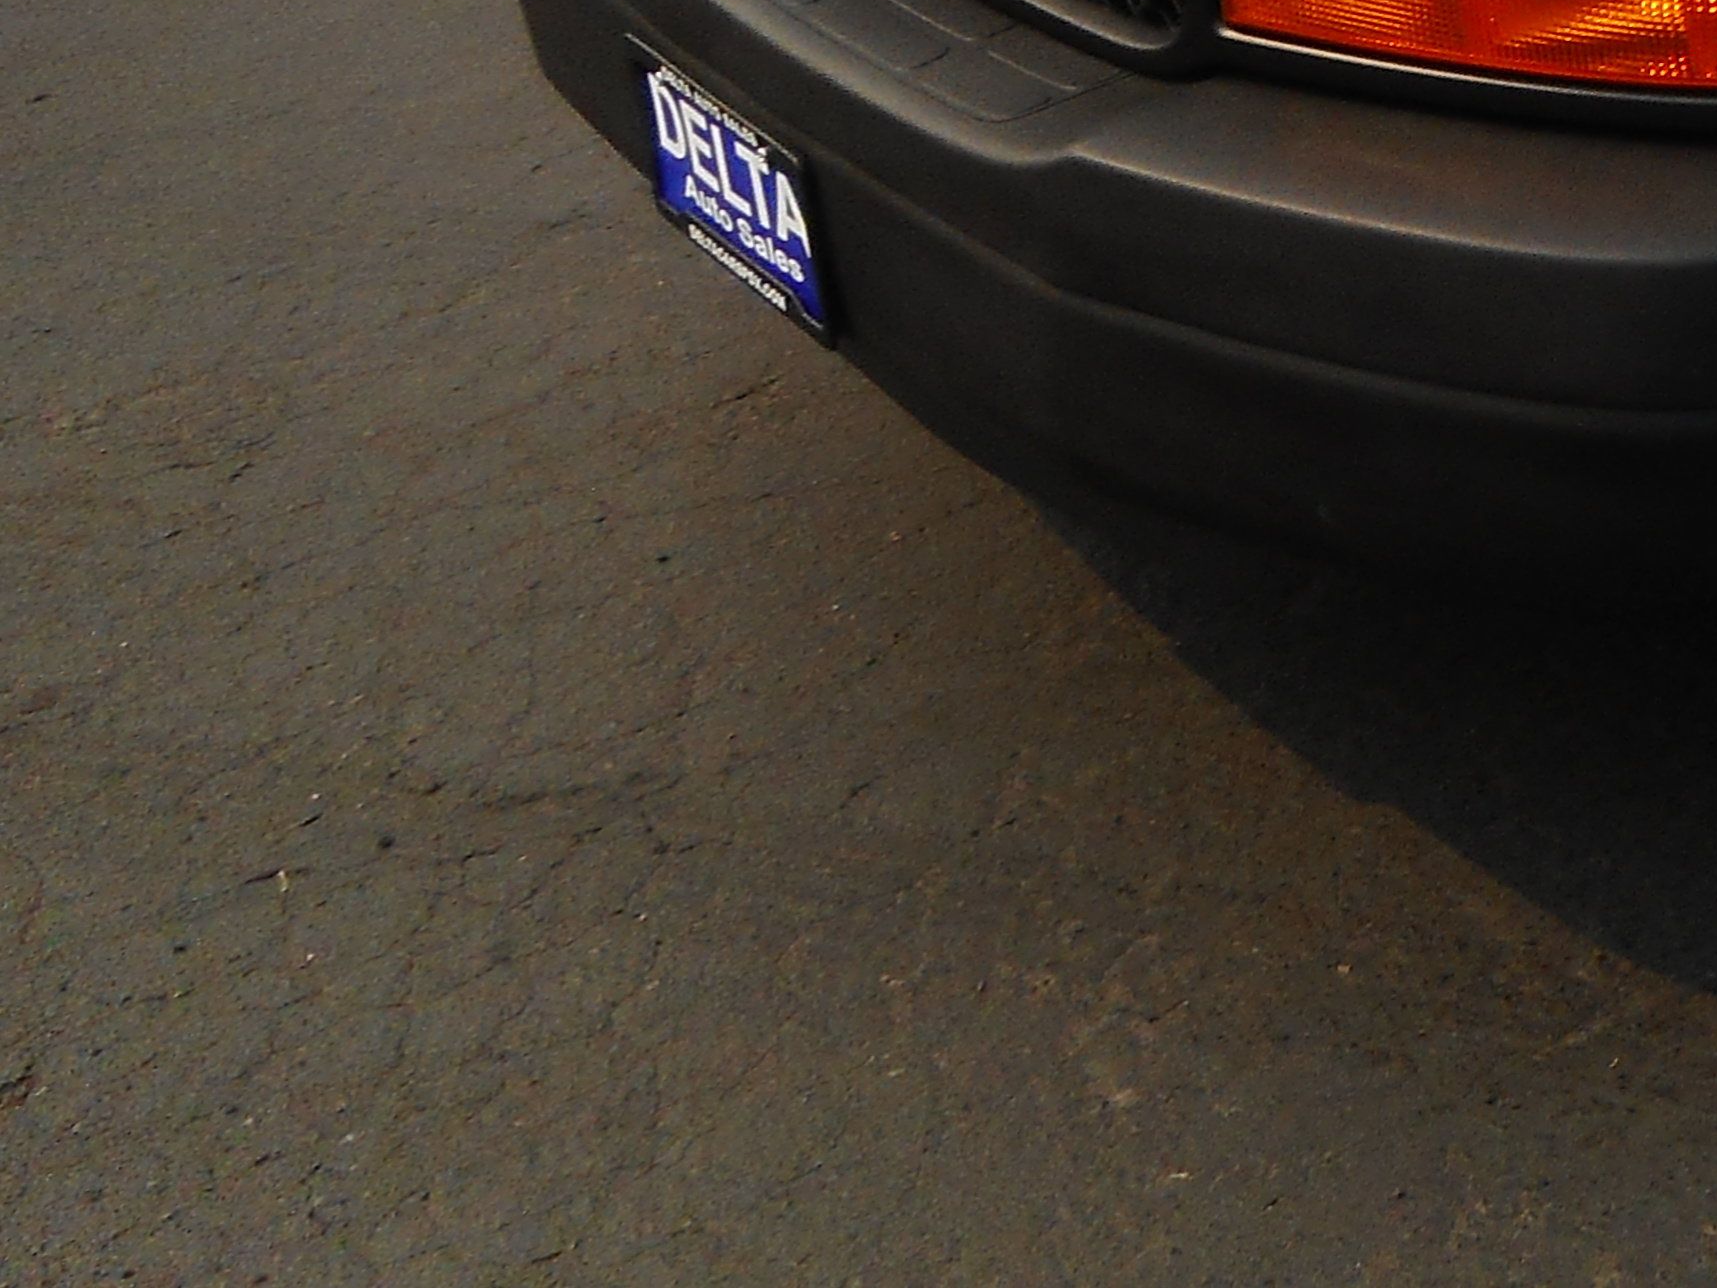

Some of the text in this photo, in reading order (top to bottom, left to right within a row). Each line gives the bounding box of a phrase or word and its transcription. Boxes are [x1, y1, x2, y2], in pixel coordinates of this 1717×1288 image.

[648, 73, 812, 259] DELTA
[685, 175, 734, 233] Auto
[737, 218, 805, 283] Sales
